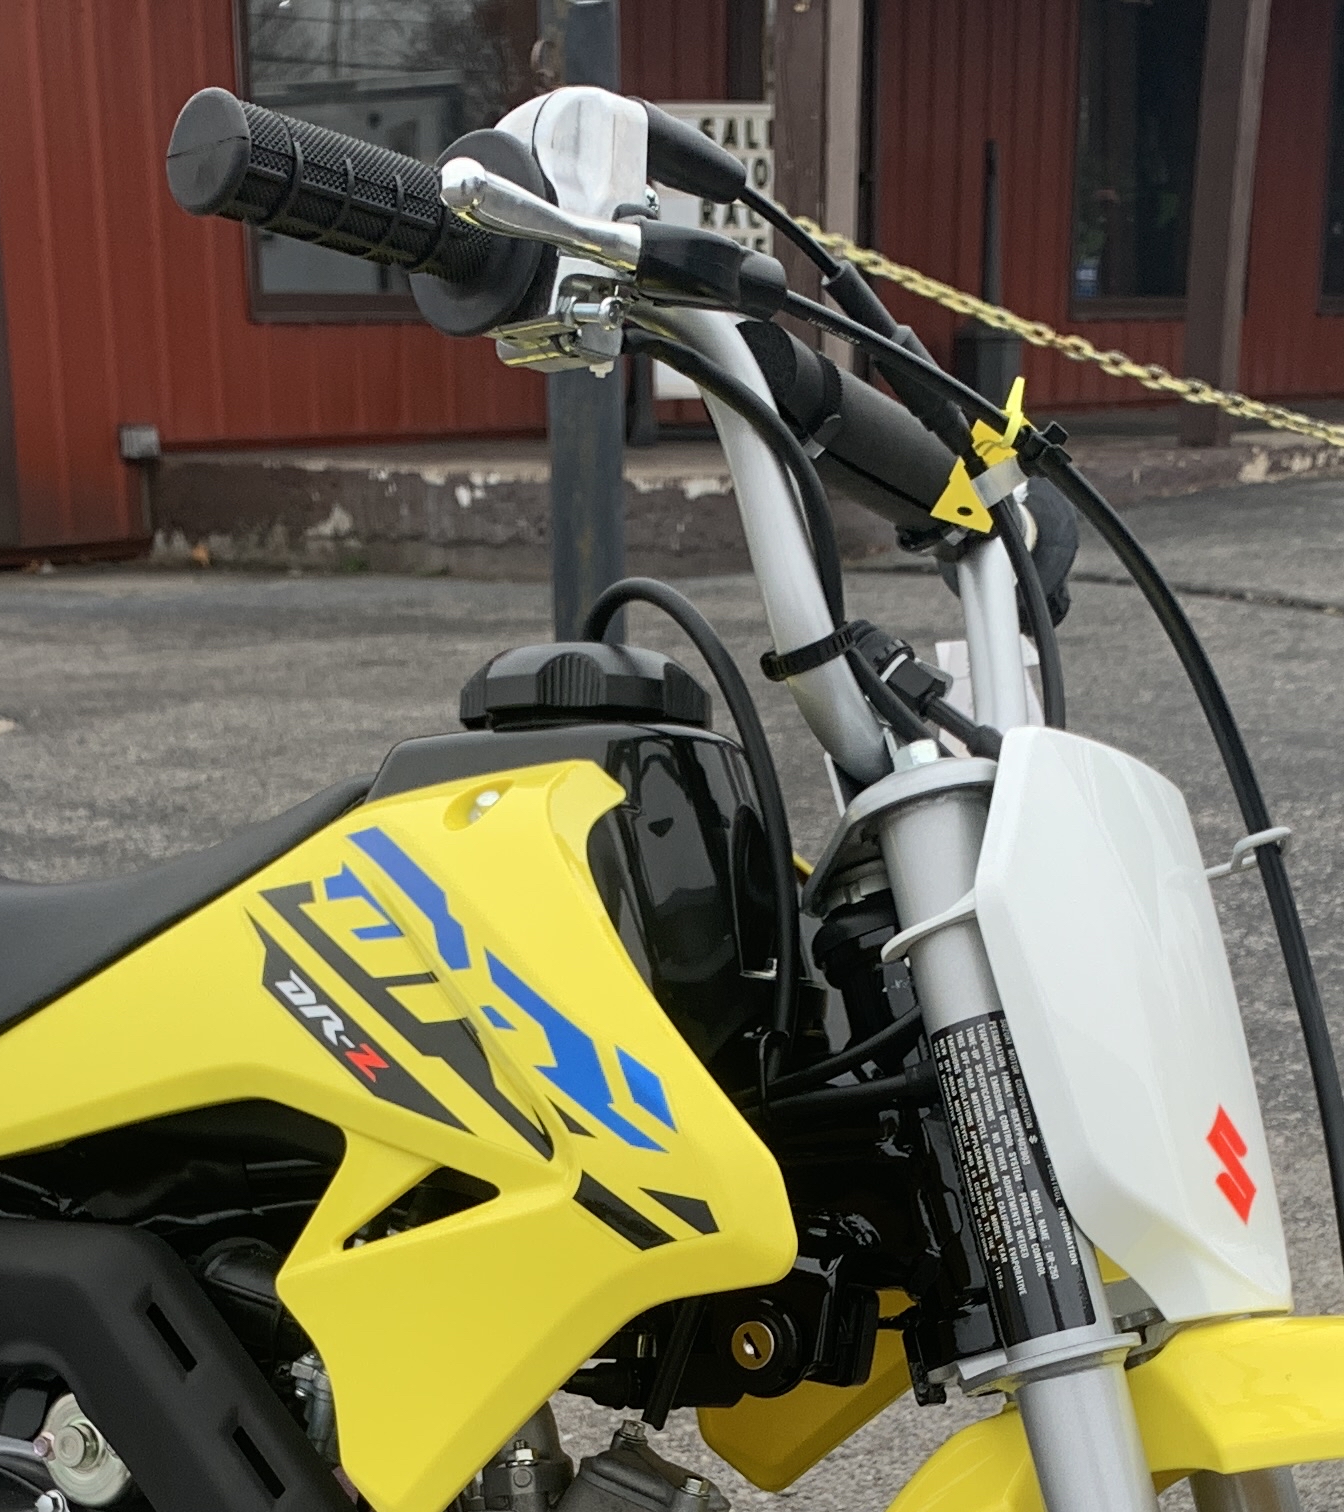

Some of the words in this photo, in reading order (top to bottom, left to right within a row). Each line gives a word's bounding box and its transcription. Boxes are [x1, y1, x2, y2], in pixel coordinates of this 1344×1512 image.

[699, 117, 774, 150] SAL
[274, 969, 391, 1084] DR-Z
[954, 1030, 965, 1048] THIS
[965, 1026, 981, 1061] TUNE-UP
[959, 1050, 976, 1089] OFF-ROAD
[973, 1063, 996, 1122] SPECIFICATIONS
[1007, 1048, 1020, 1075] MOTOR
[1014, 1077, 1033, 1129] CORPORATION
[969, 1091, 989, 1140] MOTORCYCLE
[990, 1131, 1001, 1144] NO
[976, 1022, 996, 1072] EVAPORATIVE
[988, 1074, 1005, 1112] EMISSION
[998, 1113, 1015, 1148] CONTROL
[1007, 1150, 1023, 1182] SYSTEM
[1017, 1191, 1038, 1240] PERMEATION
[1030, 1242, 1046, 1277] CONTROL
[981, 1142, 999, 1184] CONFORMS
[994, 1146, 1008, 1171] OTHER
[1000, 1070, 1015, 1098] FAMILY
[1029, 1188, 1043, 1215] MODEL
[1036, 1218, 1050, 1242] NAME
[968, 1129, 986, 1174] APPLICABLE
[983, 1190, 995, 1211] 2024
[989, 1213, 1002, 1240] MODEL
[996, 1242, 1008, 1263] YEAR
[992, 1186, 1003, 1197] TO
[1001, 1174, 1022, 1226] ADJUSTMENTS
[996, 1199, 1014, 1244] CALIFORNIA
[1014, 1228, 1030, 1259] NEEDED
[1056, 1206, 1079, 1266] INFORMATION
[1007, 1246, 1027, 1296] EVAPORATIVE
